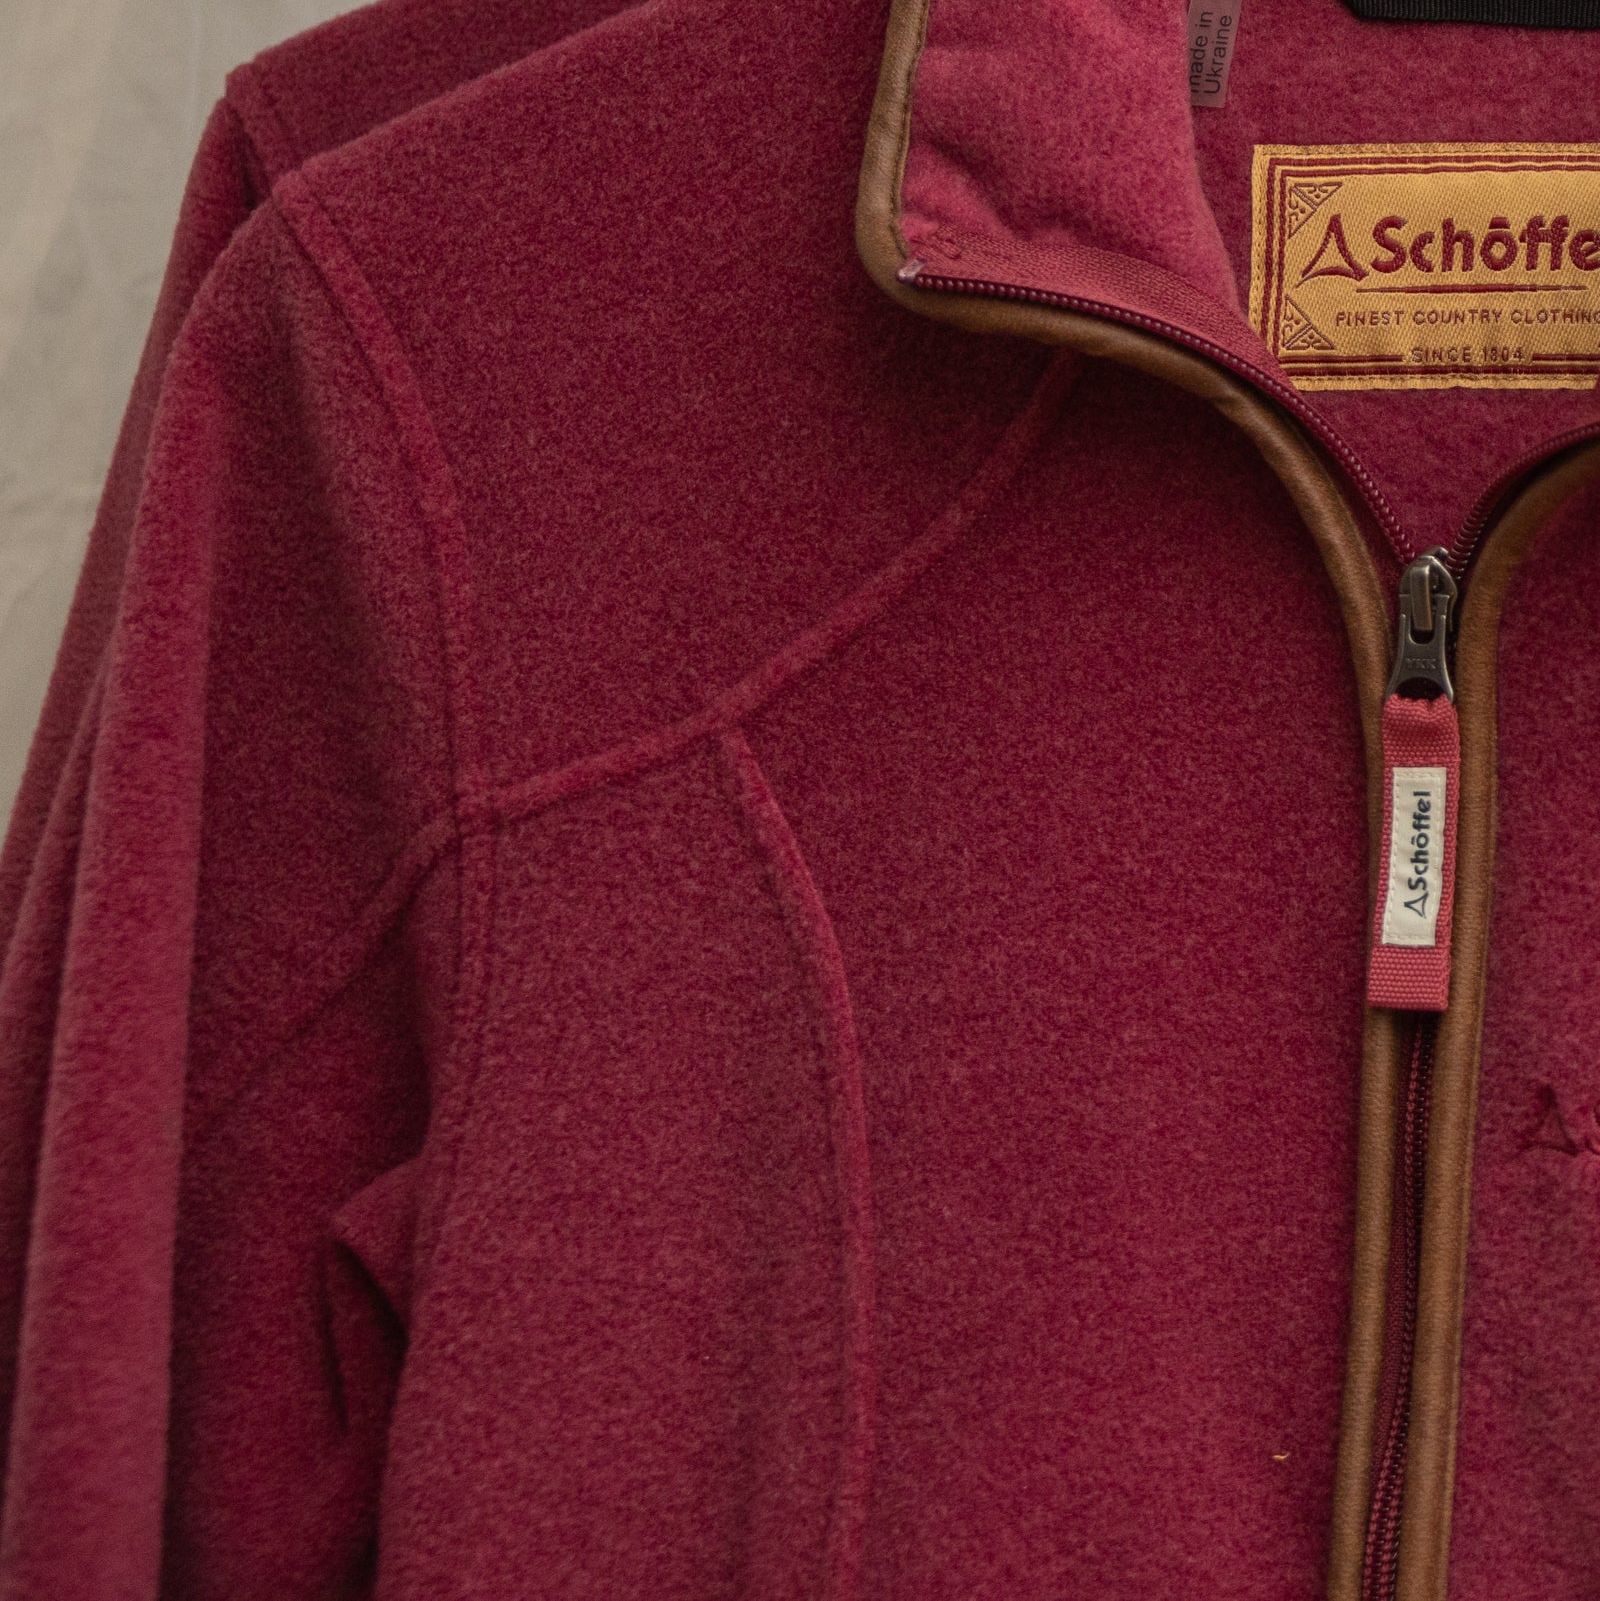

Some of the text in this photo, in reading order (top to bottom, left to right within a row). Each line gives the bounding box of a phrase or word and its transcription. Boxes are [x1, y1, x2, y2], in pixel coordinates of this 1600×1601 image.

[1195, 11, 1214, 28] in
[1203, 14, 1233, 95] Ukraine
[1336, 310, 1405, 327] FINEST
[1412, 309, 1503, 326] COUNTRY
[1411, 348, 1472, 364] SINCE
